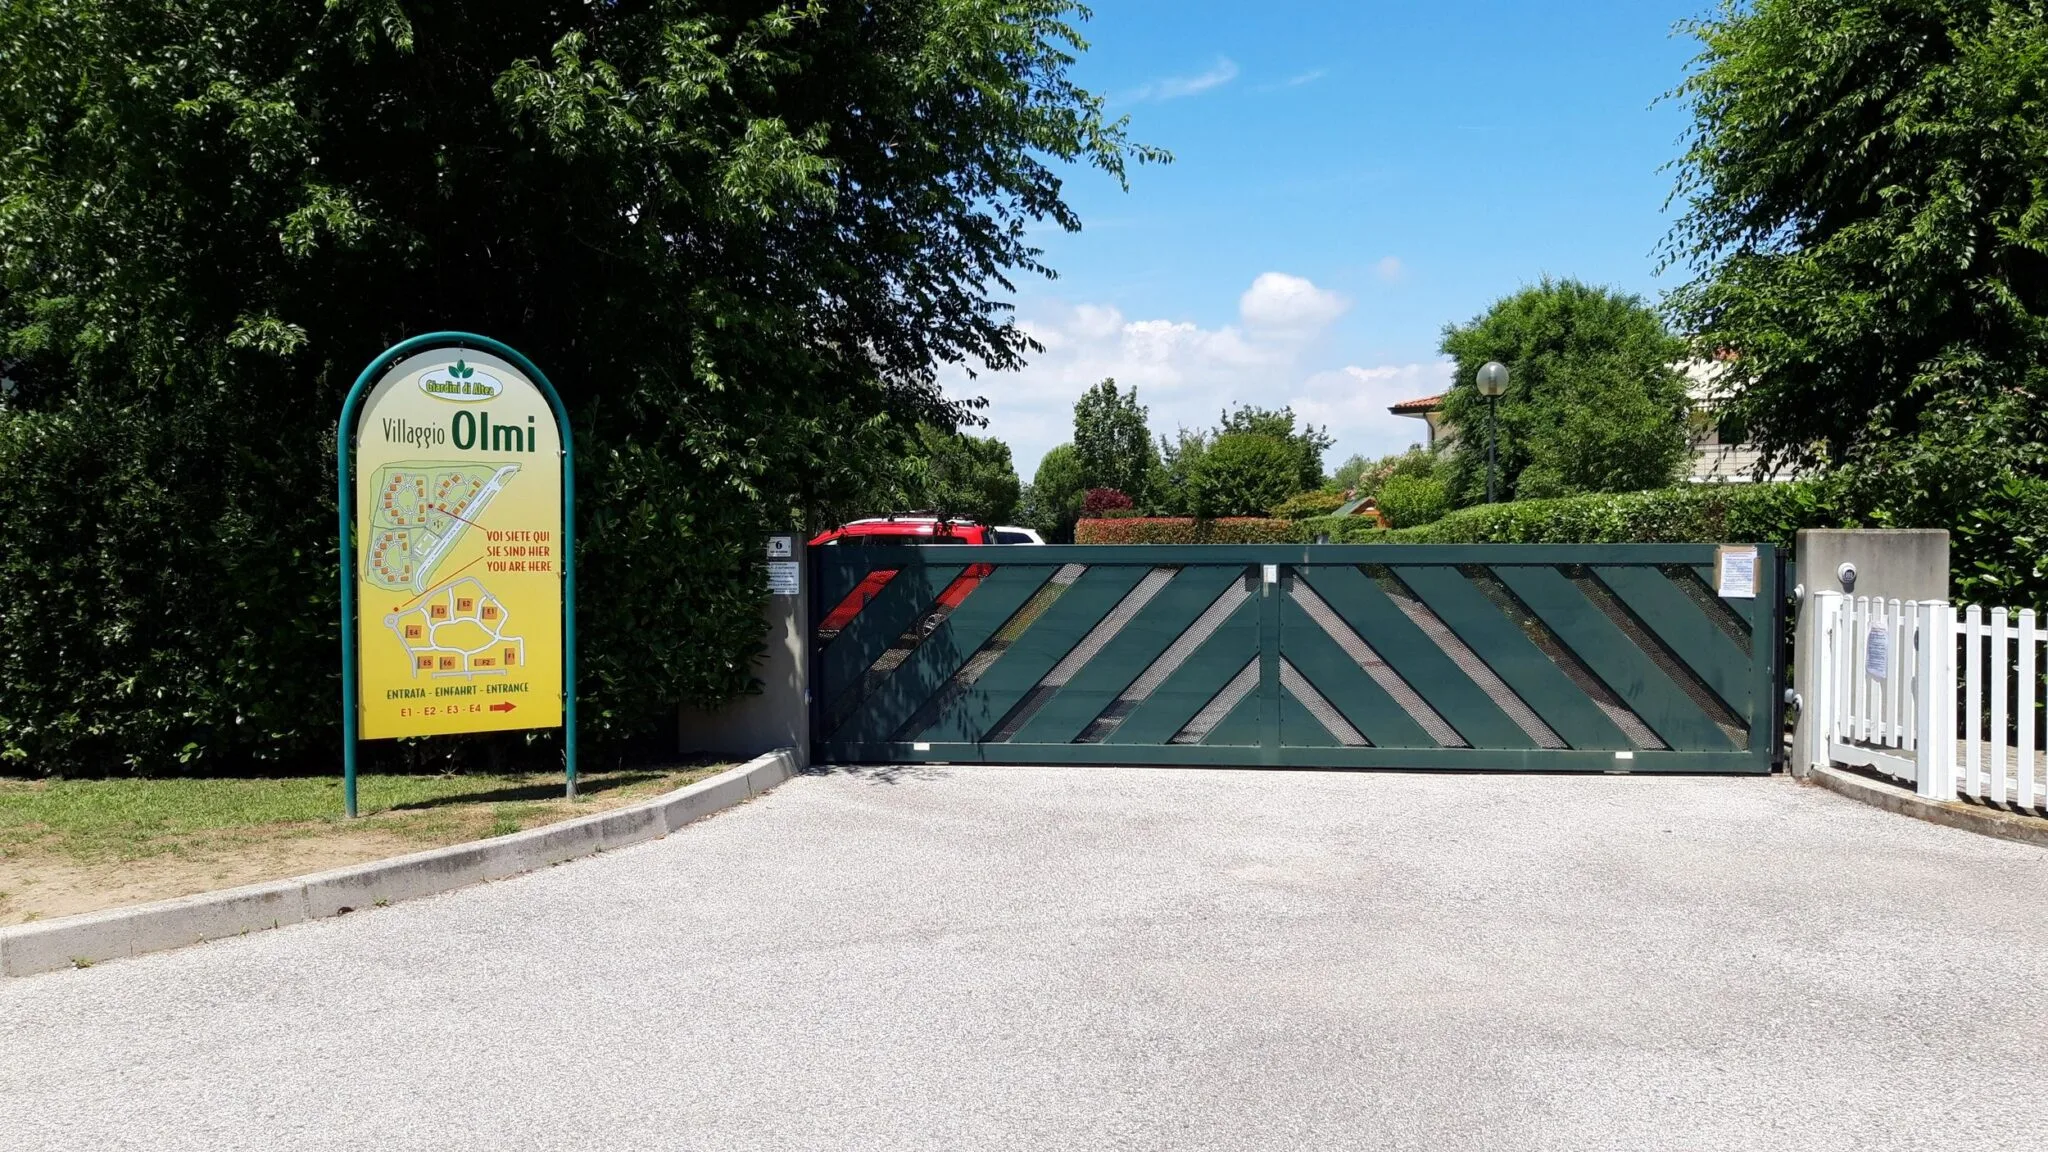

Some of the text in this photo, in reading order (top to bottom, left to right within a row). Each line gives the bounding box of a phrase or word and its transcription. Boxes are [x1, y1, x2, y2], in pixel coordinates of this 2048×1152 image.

[426, 380, 494, 396] Giardini di Altea
[382, 410, 535, 452] Villaggio Olmi
[486, 530, 550, 544] VOI SIETE QUI
[486, 546, 550, 556] SIE SIND HIER
[776, 540, 782, 550] 6
[486, 560, 552, 572] YOU ARE HERE
[387, 688, 426, 700] ENTRATA
[436, 685, 476, 697] EINFAHRT
[486, 682, 528, 694] ENTRANCE
[400, 708, 412, 717] E1
[424, 706, 436, 716] E2
[447, 705, 458, 714] E3
[470, 704, 481, 712] E4
